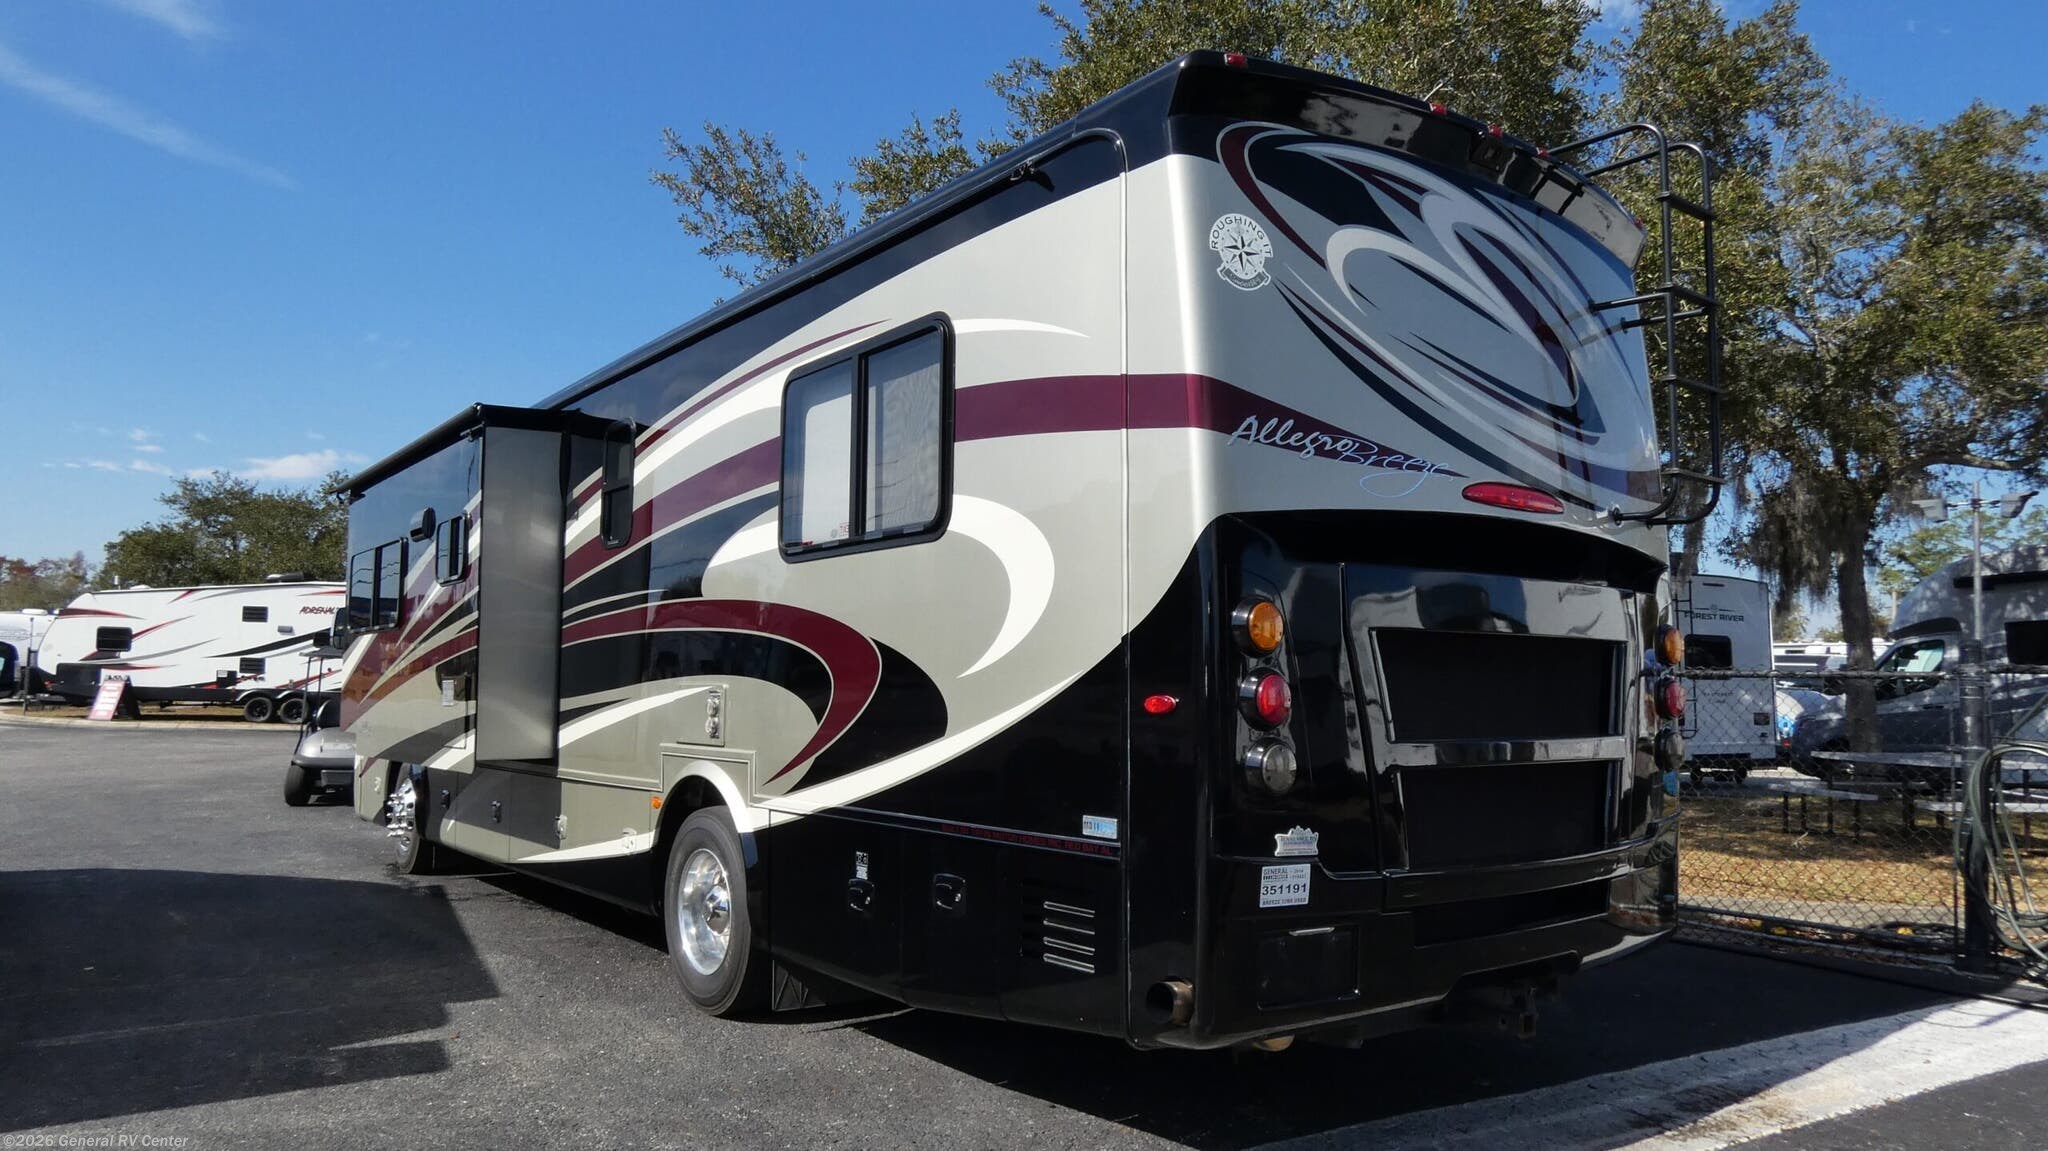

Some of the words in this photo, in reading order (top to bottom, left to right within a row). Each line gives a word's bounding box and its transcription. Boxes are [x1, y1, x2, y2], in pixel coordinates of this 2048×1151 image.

[1211, 215, 1265, 249] ROUGHING
[1263, 243, 1272, 256] IT
[1227, 415, 1351, 459] Allegro
[1319, 434, 1453, 497] Breeze
[299, 606, 336, 614] ADRENAL
[1719, 614, 1745, 622] RIVER
[1262, 883, 1307, 896] 351191
